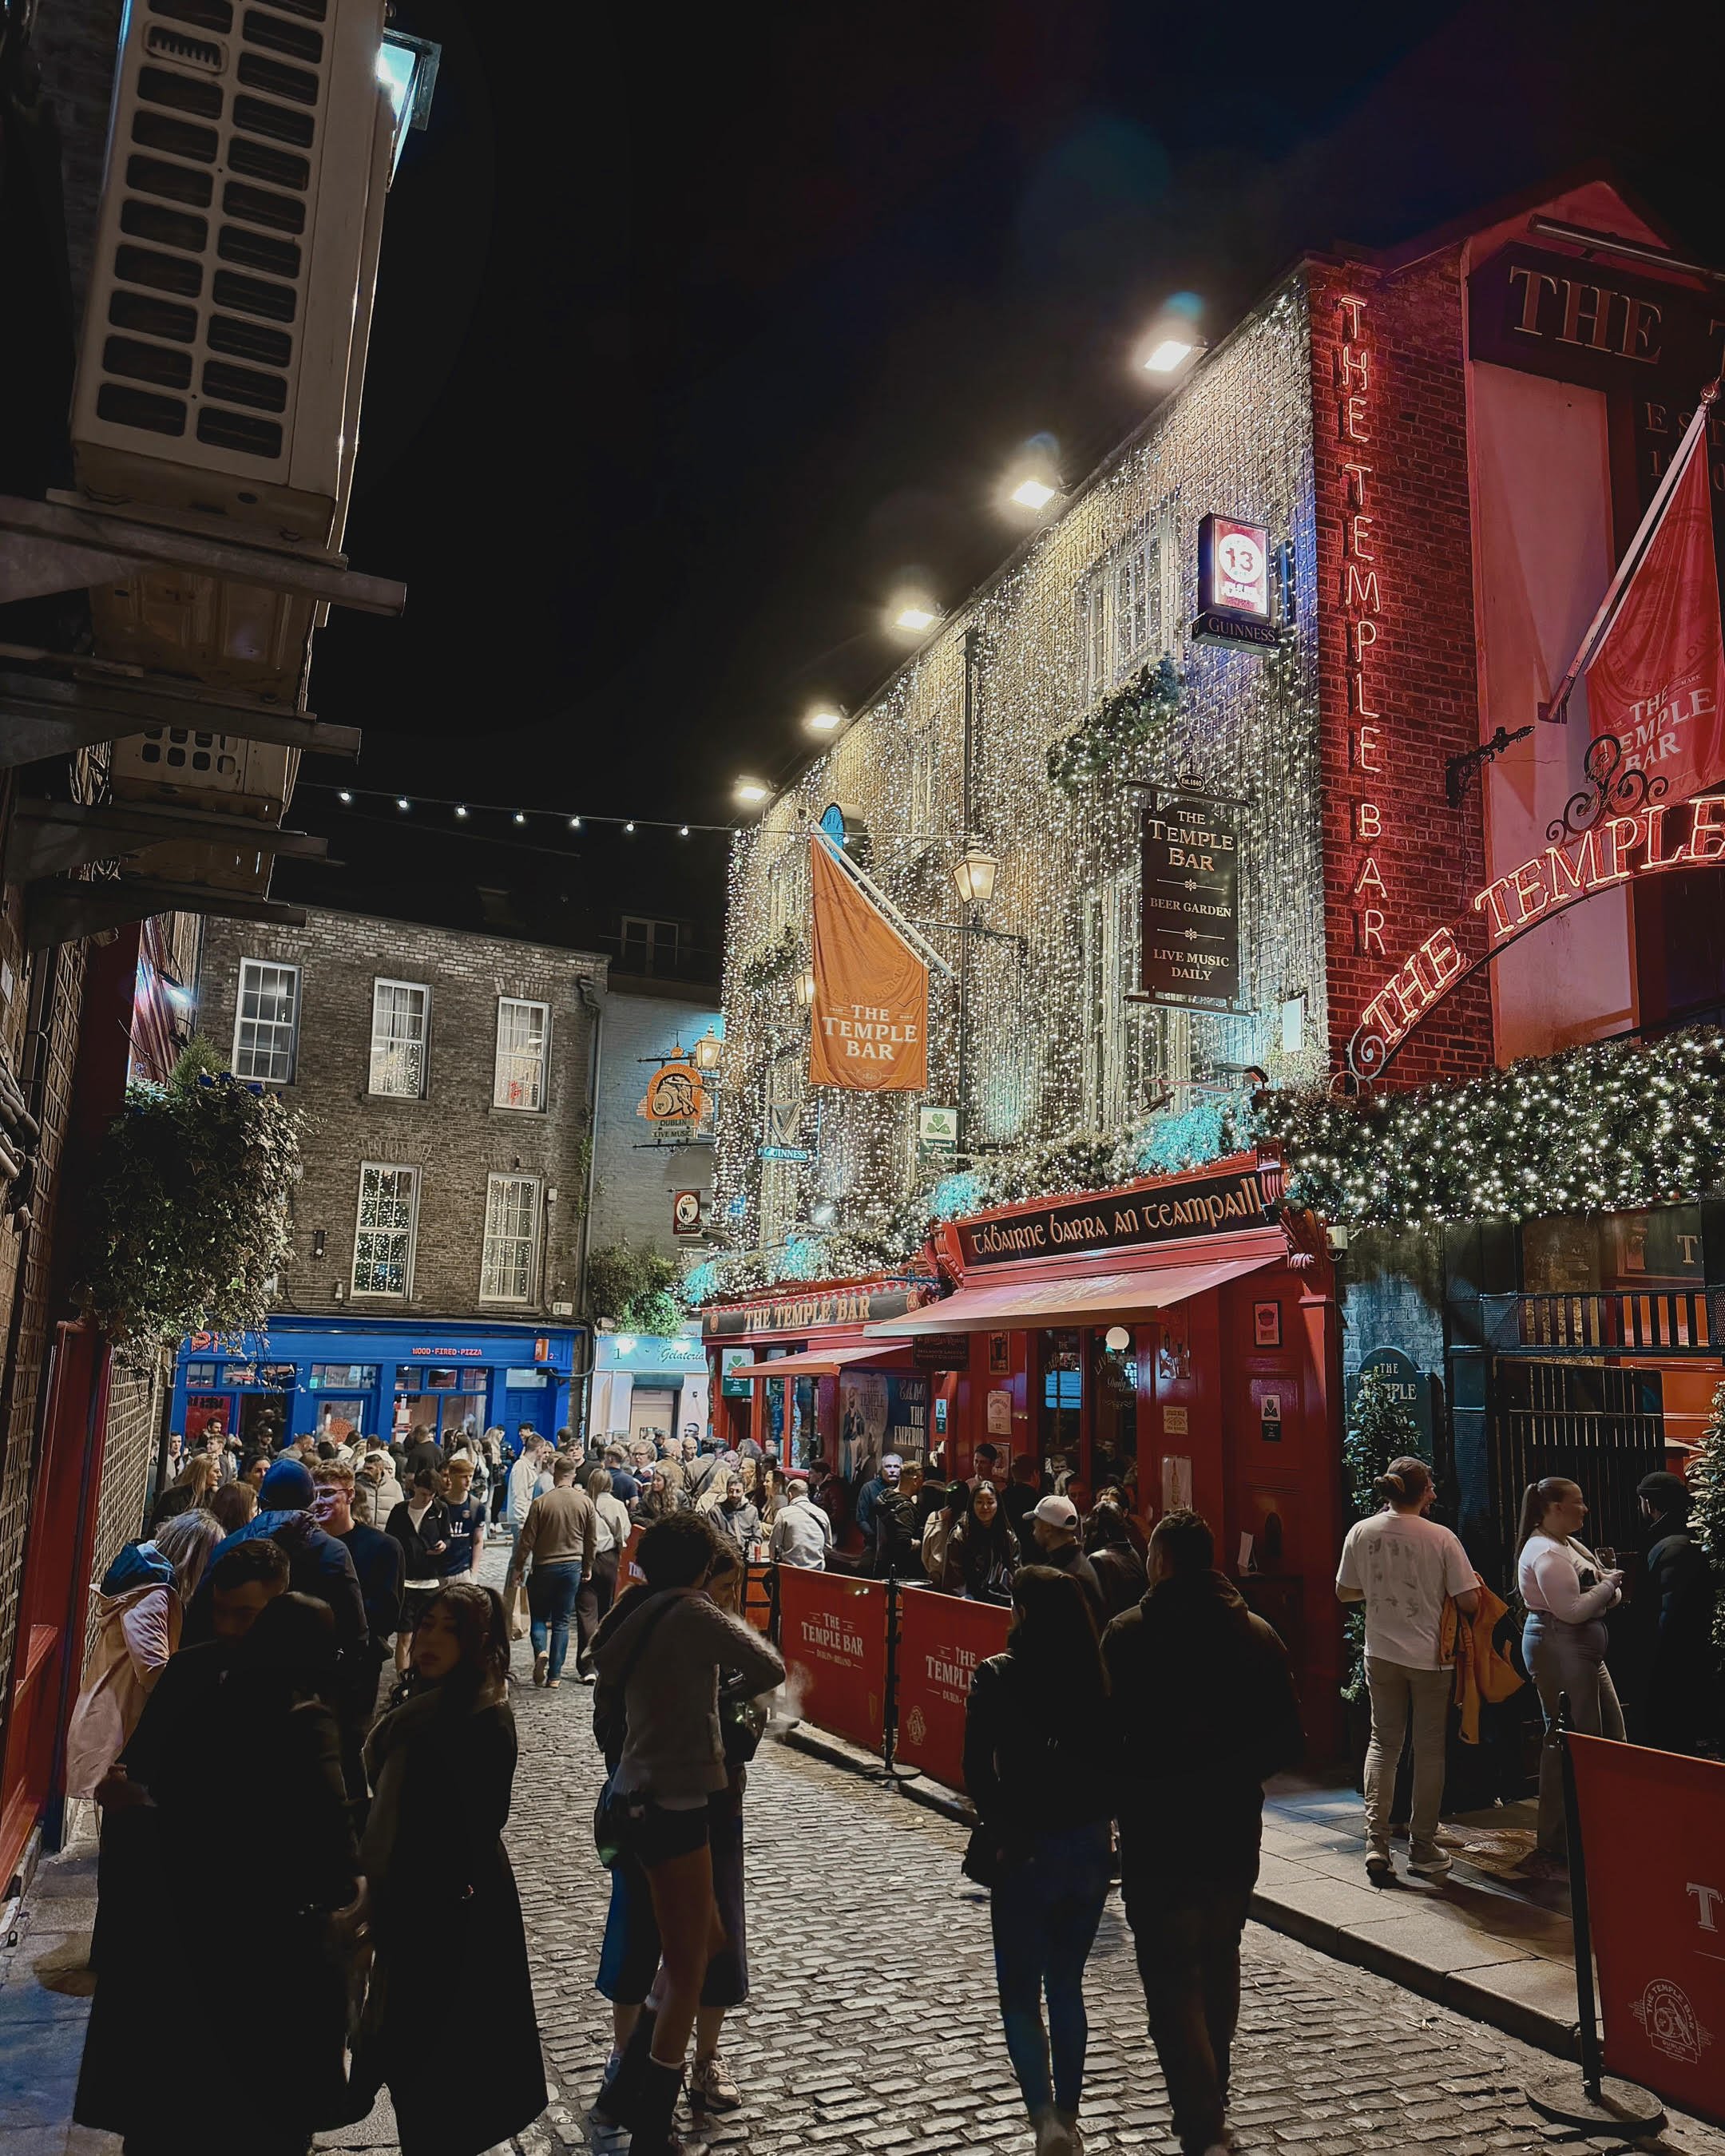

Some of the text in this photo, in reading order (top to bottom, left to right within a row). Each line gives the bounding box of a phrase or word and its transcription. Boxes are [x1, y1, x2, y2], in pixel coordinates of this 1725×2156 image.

[1509, 266, 1663, 364] THE
[1225, 547, 1254, 573] 13
[1208, 616, 1276, 642] GUINNESS
[1339, 295, 1388, 956] THE TEMPLE BAR
[1628, 684, 1668, 723] THE
[1624, 731, 1681, 773] BAR
[1176, 810, 1206, 825] THE
[1148, 818, 1235, 851] TEMPLE
[1168, 846, 1215, 872] BAR
[1149, 897, 1232, 918] BEER GARDEN
[1361, 796, 1725, 1044] THE TEMPLE
[1153, 949, 1230, 967] LIVE MUSIC
[1171, 966, 1212, 981] DAILY
[851, 1005, 890, 1021] THE
[822, 1017, 918, 1043] TEMPLE
[845, 1040, 894, 1060] BAR
[763, 1146, 807, 1159] GUINNESS
[744, 1295, 871, 1332] THE TEMPLE BAR
[660, 1348, 704, 1362] Gelateria
[1380, 1363, 1398, 1374] THE
[910, 1406, 925, 1425] THE
[823, 1612, 840, 1630] THE
[801, 1622, 863, 1657] TEMPLE BAR
[954, 1646, 977, 1668] THE
